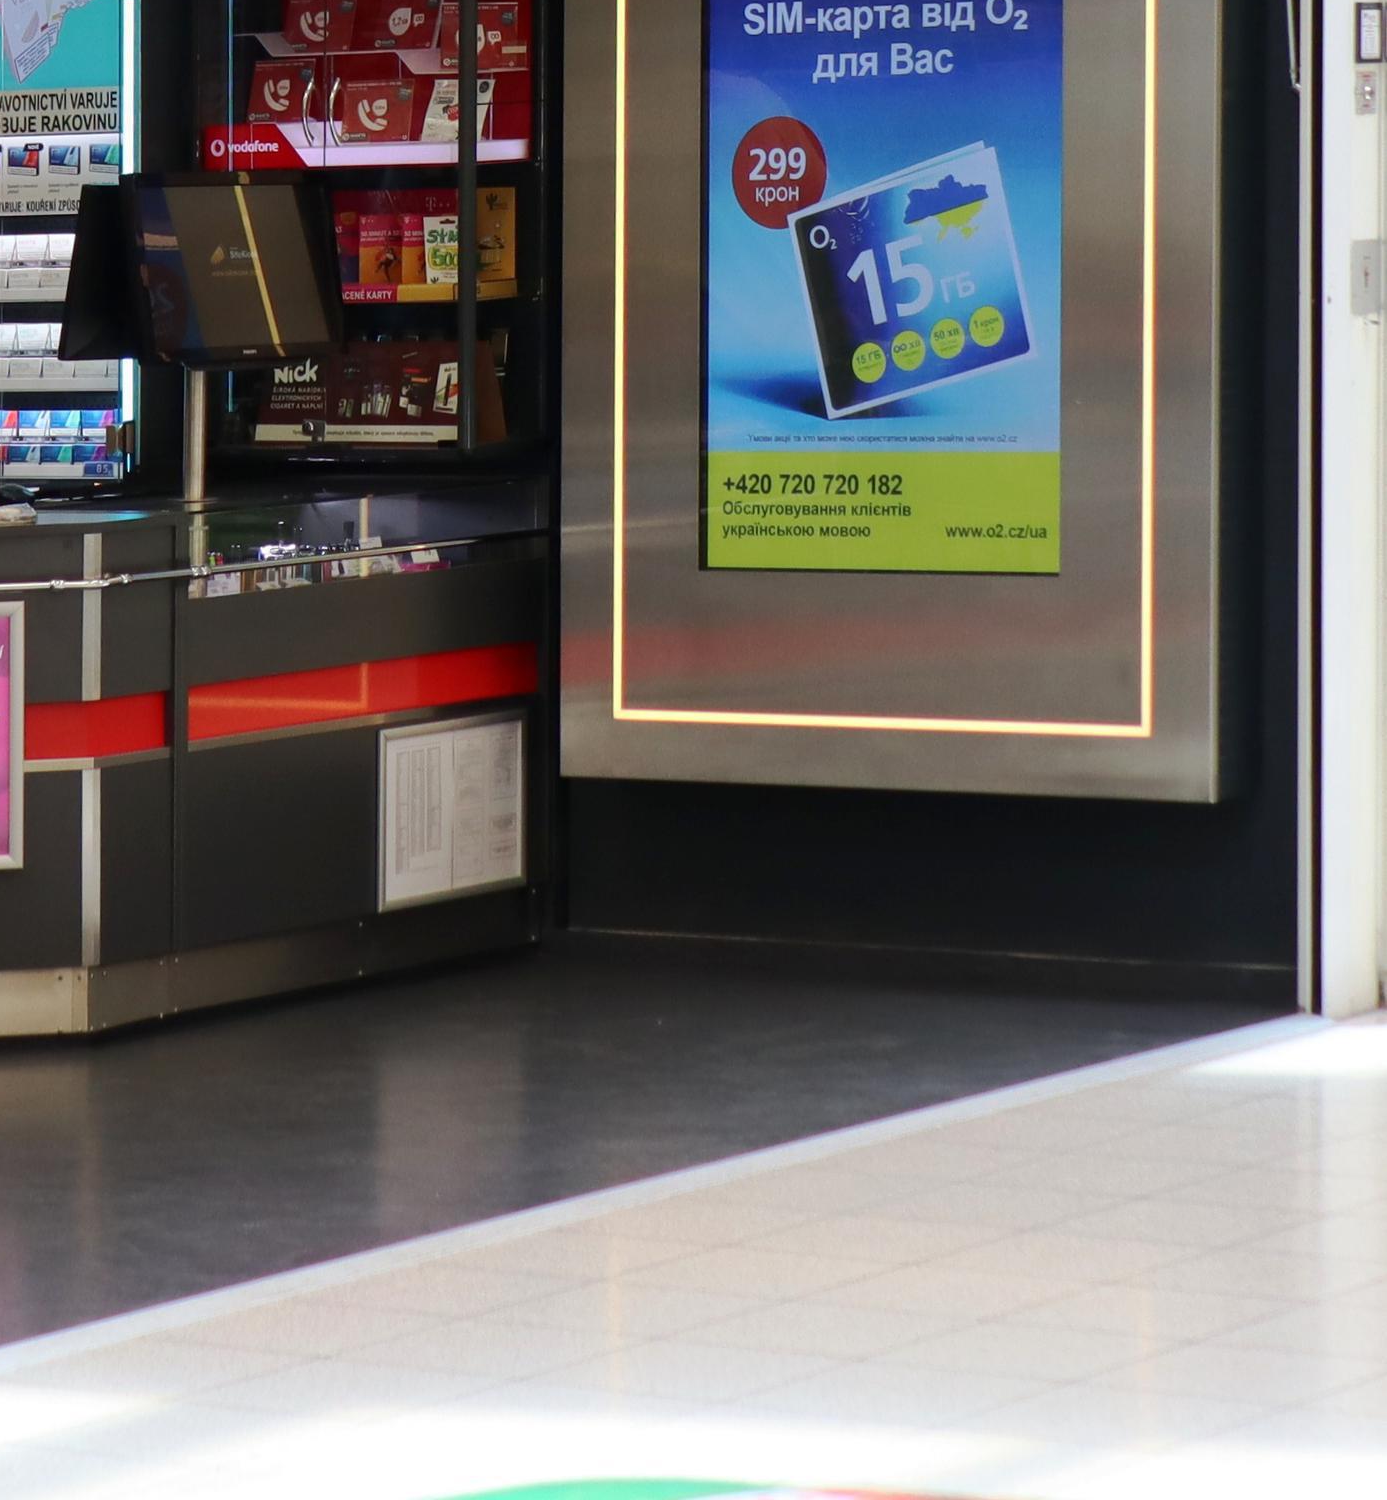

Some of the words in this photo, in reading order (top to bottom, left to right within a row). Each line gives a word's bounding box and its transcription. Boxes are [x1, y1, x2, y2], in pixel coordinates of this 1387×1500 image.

[743, 1, 911, 40] SIM-карта
[812, 50, 879, 84] для
[890, 42, 954, 76] Вас
[69, 91, 118, 110] VARUJE
[41, 112, 118, 133] RAKOVINU
[226, 140, 279, 155] vodafone
[748, 147, 807, 181] 299
[25, 198, 57, 213] KOUŘENÍ
[754, 185, 800, 207] крон
[846, 234, 935, 326] 15
[939, 270, 976, 304] ГБ
[366, 289, 392, 301] KARTY
[722, 473, 772, 495] +420
[779, 474, 816, 495] 720
[822, 474, 860, 496] 720
[867, 474, 904, 496] 182
[722, 500, 847, 519] Обслуговування
[851, 502, 912, 517] клієнтів
[721, 522, 815, 539] українською
[819, 525, 871, 538] мовою
[945, 523, 1048, 540] www.o2.cz/ua
